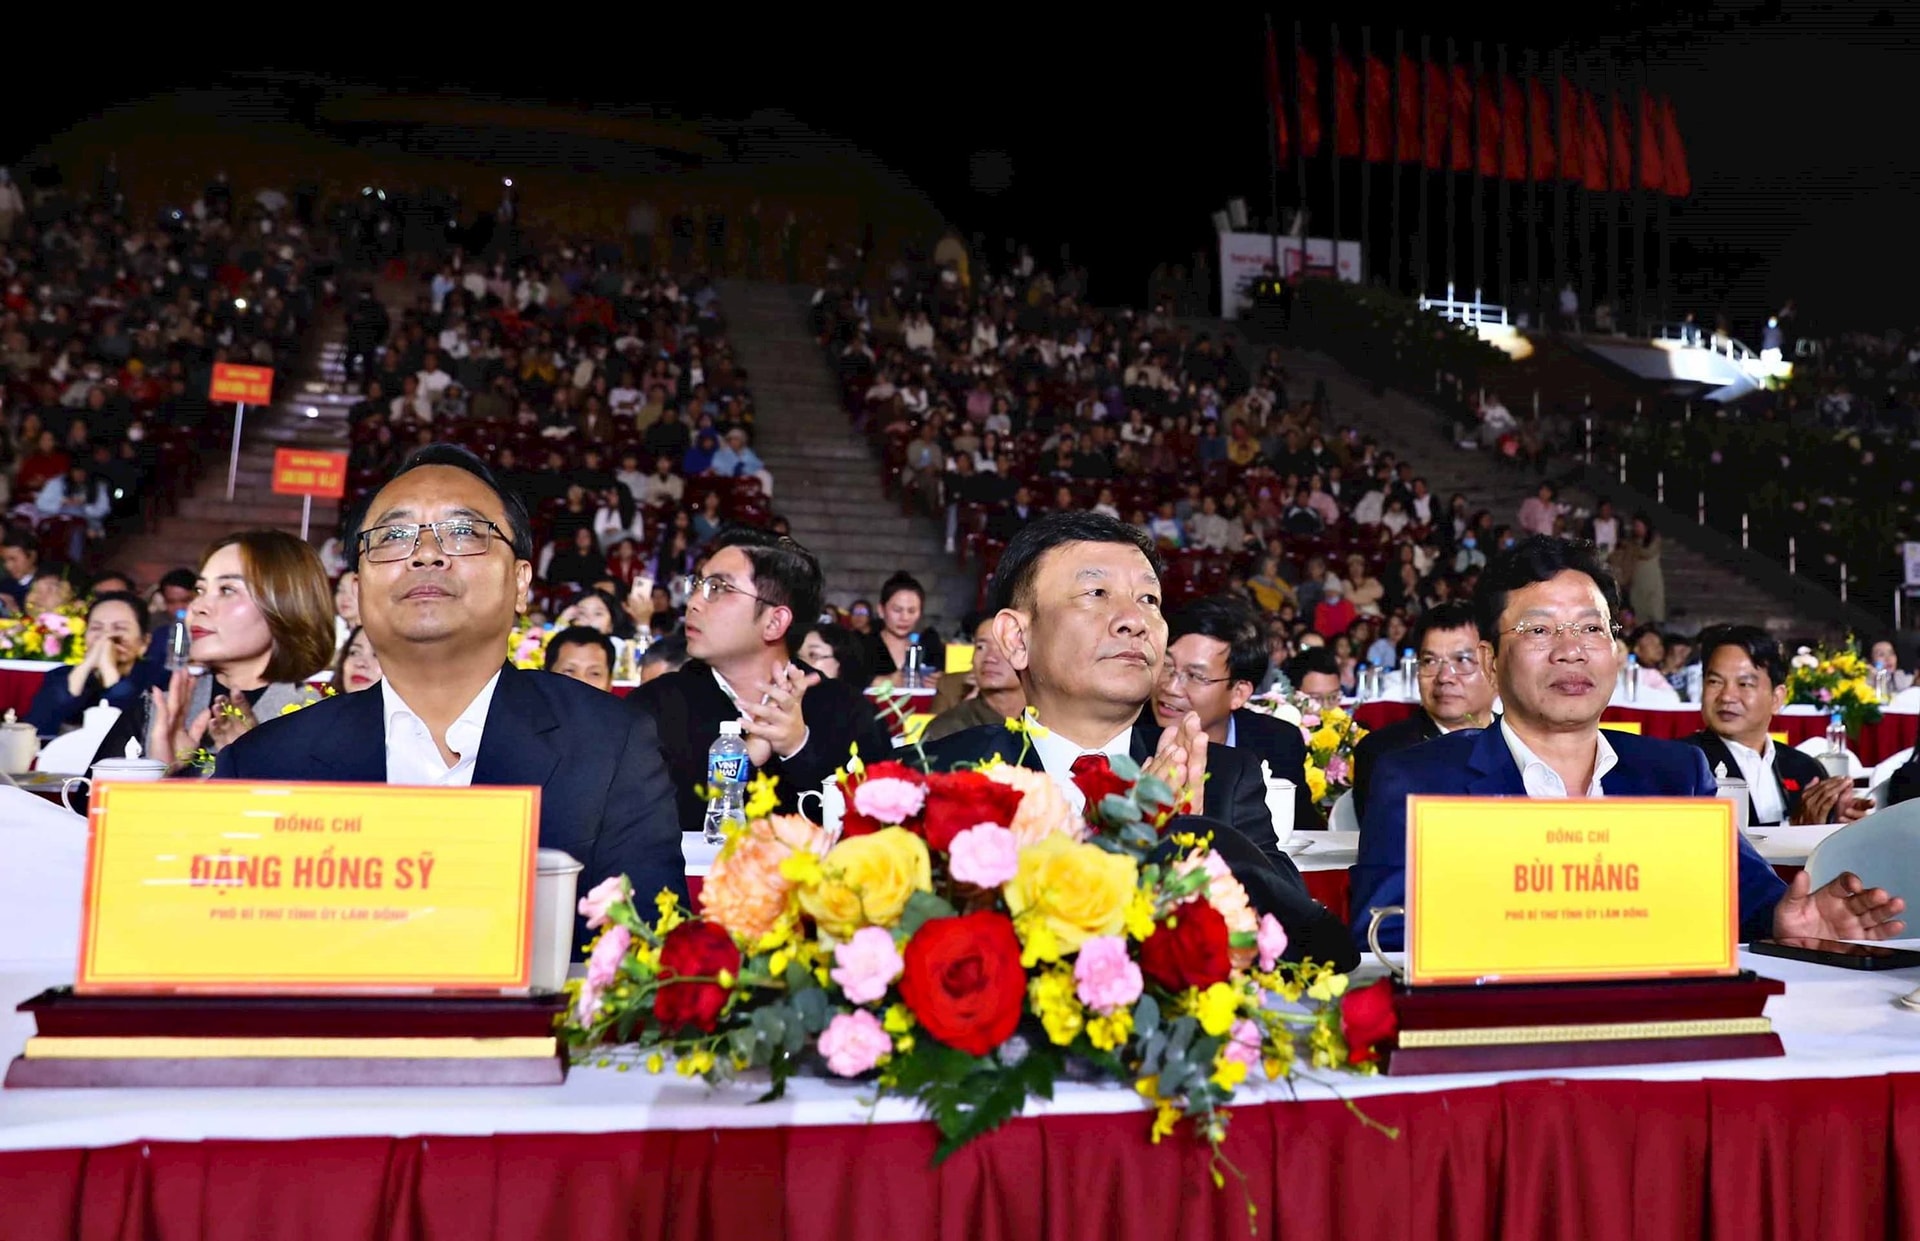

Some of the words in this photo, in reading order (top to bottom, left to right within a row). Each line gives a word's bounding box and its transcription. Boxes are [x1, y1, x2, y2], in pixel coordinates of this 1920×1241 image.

[332, 812, 364, 832] CHÍ
[1588, 828, 1610, 844] CHÍ
[190, 847, 283, 895] ĐẶNG
[395, 850, 435, 890] SỸ
[1514, 857, 1553, 893] BÙI
[1562, 852, 1640, 892] THẮNG
